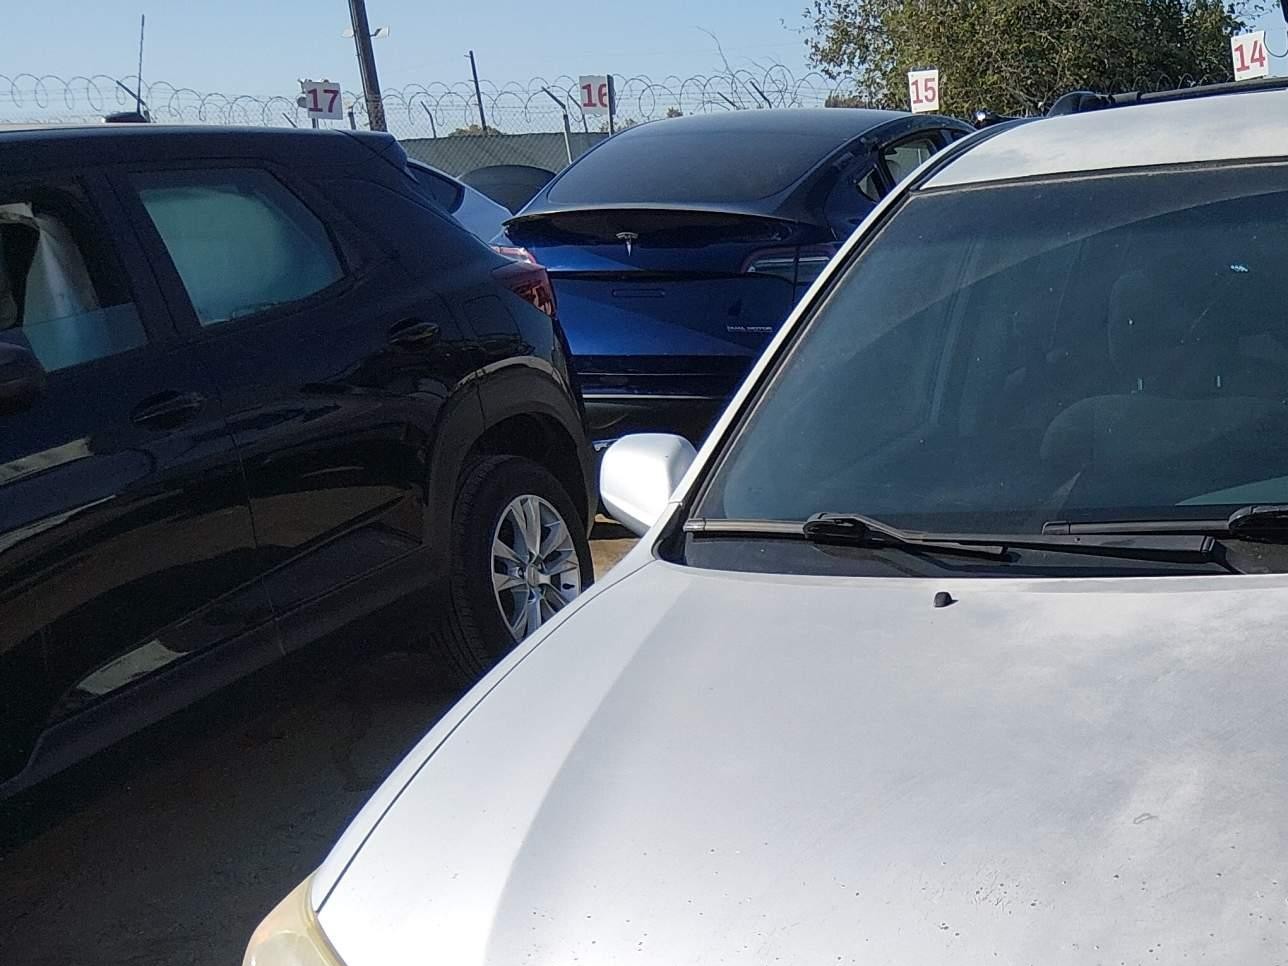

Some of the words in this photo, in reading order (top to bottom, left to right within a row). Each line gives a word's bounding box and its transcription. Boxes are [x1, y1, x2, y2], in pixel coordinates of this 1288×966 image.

[1234, 40, 1266, 73] 14
[307, 88, 340, 113] 17
[581, 83, 608, 107] 16
[911, 77, 938, 104] 15
